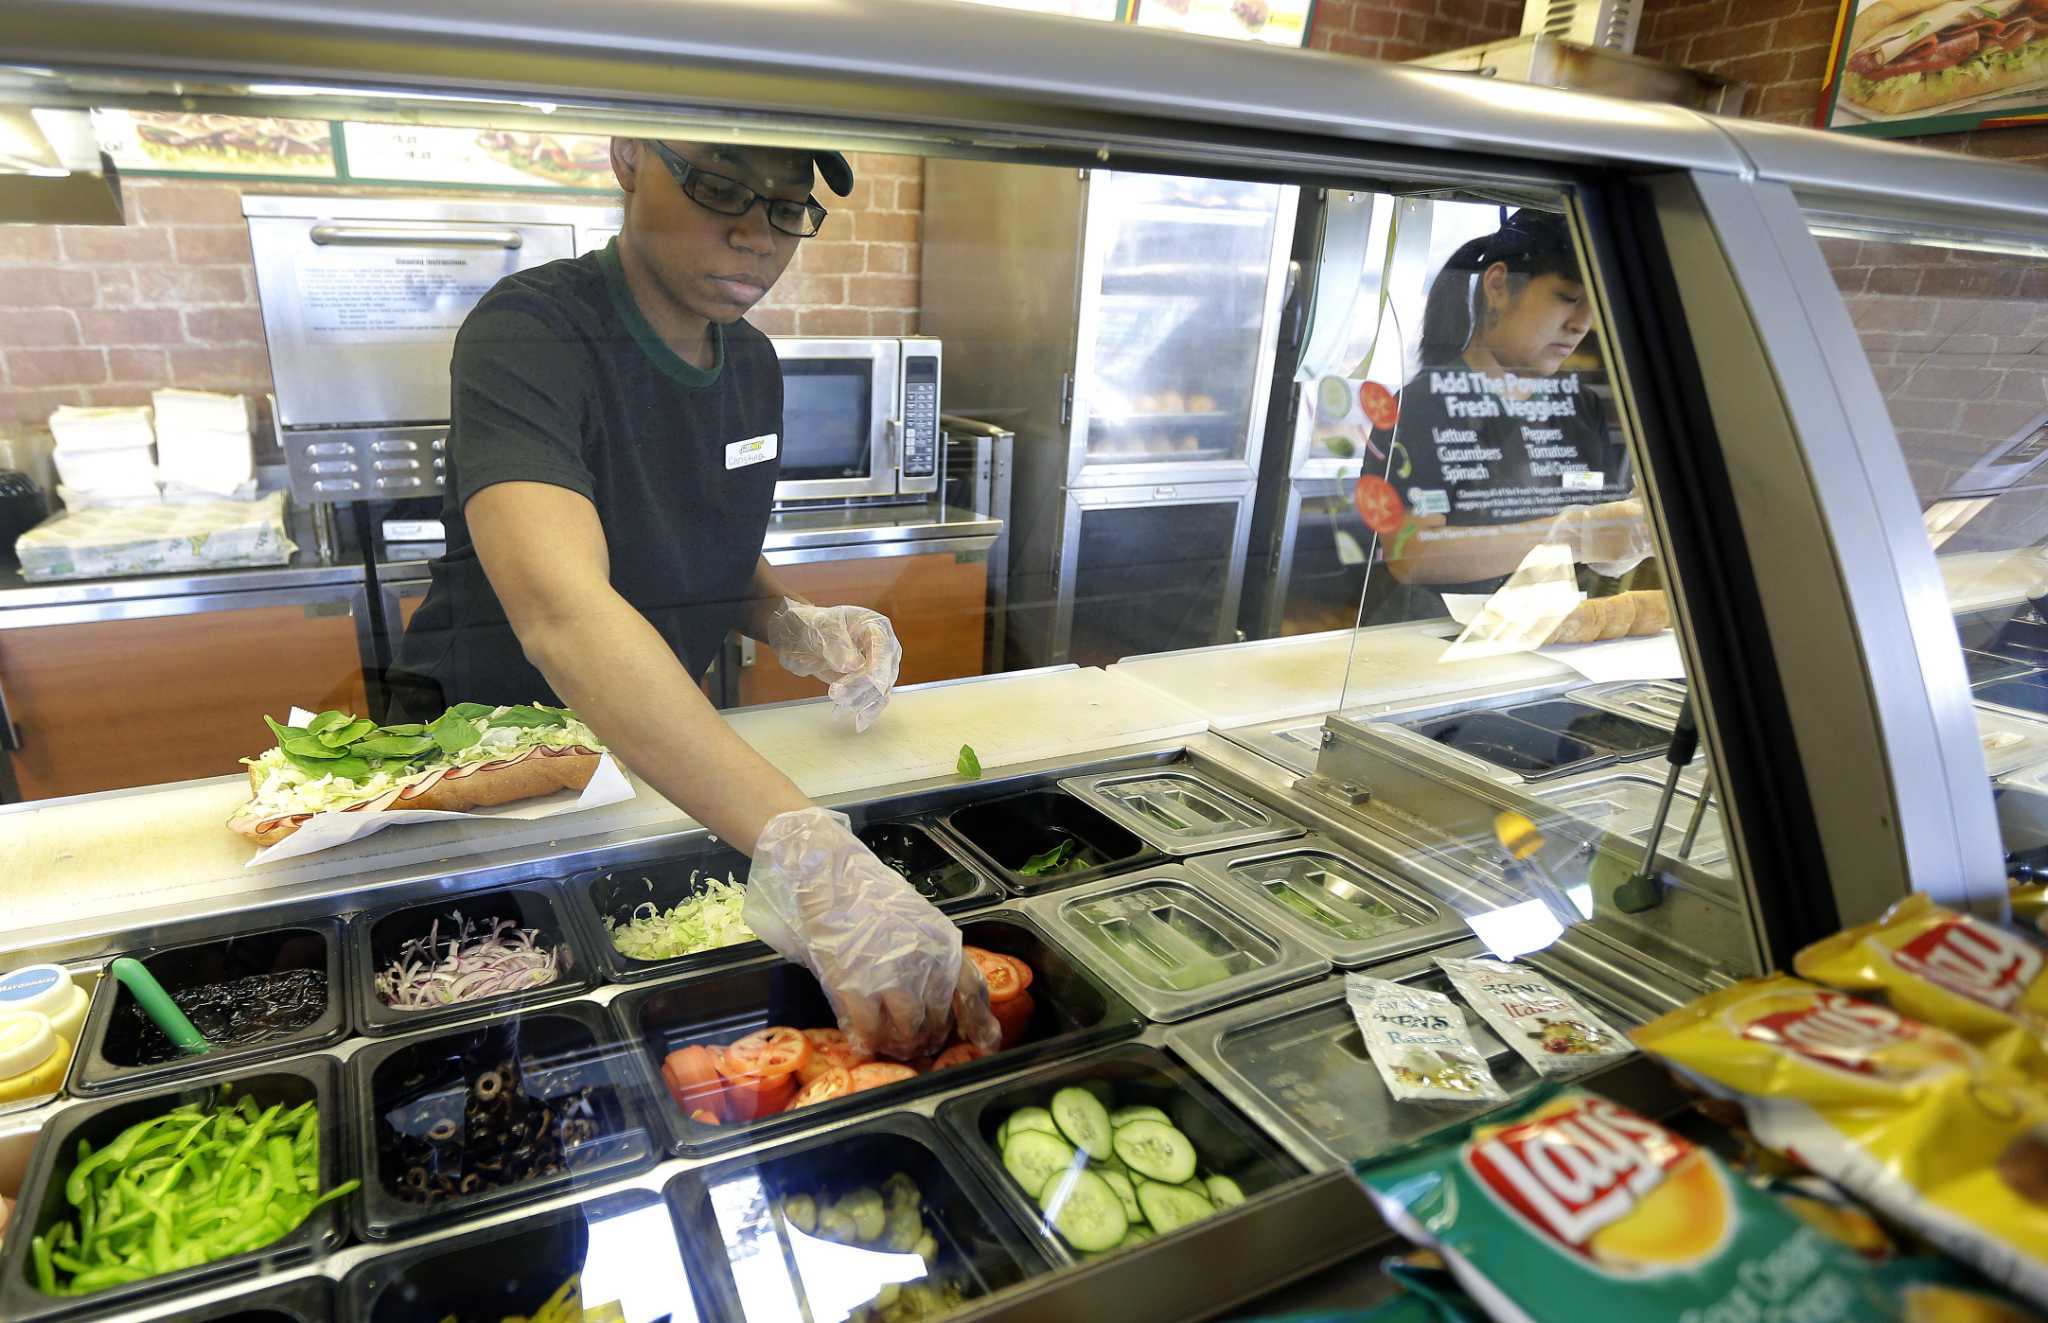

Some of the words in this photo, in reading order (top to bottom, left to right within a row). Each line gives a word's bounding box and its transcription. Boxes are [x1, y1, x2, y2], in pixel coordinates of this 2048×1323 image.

[1430, 371, 1470, 394] Add
[1468, 372, 1504, 394] The
[1504, 373, 1559, 394] Power
[1560, 373, 1580, 394] of
[1445, 395, 1499, 417] Fresh
[1500, 395, 1577, 422] Veggies!
[1432, 427, 1478, 443] Lettuce
[1520, 426, 1564, 444] Peppers
[1437, 445, 1503, 462] Cucumbers
[1525, 444, 1578, 459] Tomatoes
[1441, 464, 1489, 484] Spinach
[1529, 461, 1550, 477] Red
[1478, 1098, 1680, 1246] Lay's
